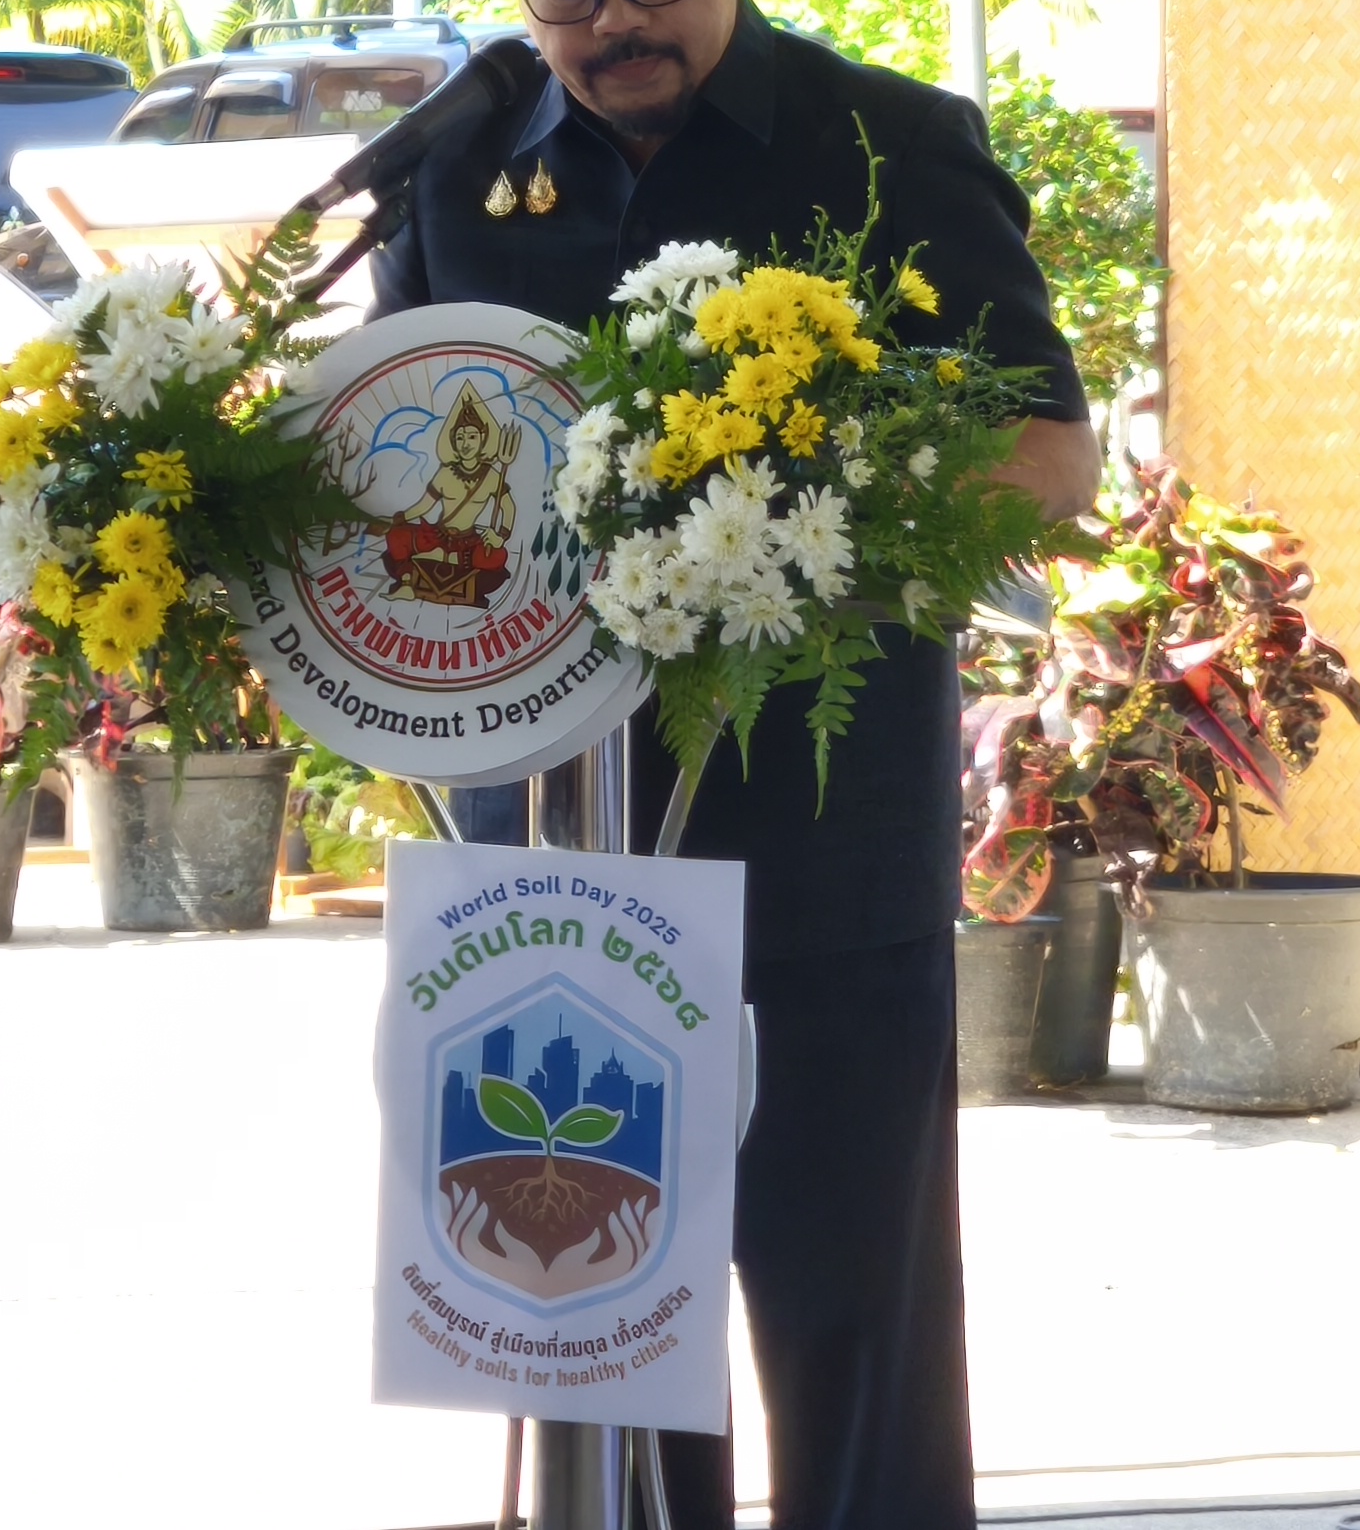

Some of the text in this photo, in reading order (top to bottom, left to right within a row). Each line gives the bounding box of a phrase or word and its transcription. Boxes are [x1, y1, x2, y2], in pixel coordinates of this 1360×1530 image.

[317, 566, 555, 670] กรมพัฒนาที่ดิน
[270, 623, 465, 738] Development
[476, 644, 610, 734] Departm
[436, 875, 682, 946] World Soil Day 2025
[406, 910, 710, 1031] วันดินโลก ๒๕๖๘
[401, 1262, 490, 1342] ดินที่สมบูรณ์
[491, 1327, 608, 1360] สู่เมืองที่สมดุล
[406, 1309, 679, 1387] Healthy soils for healthy cities
